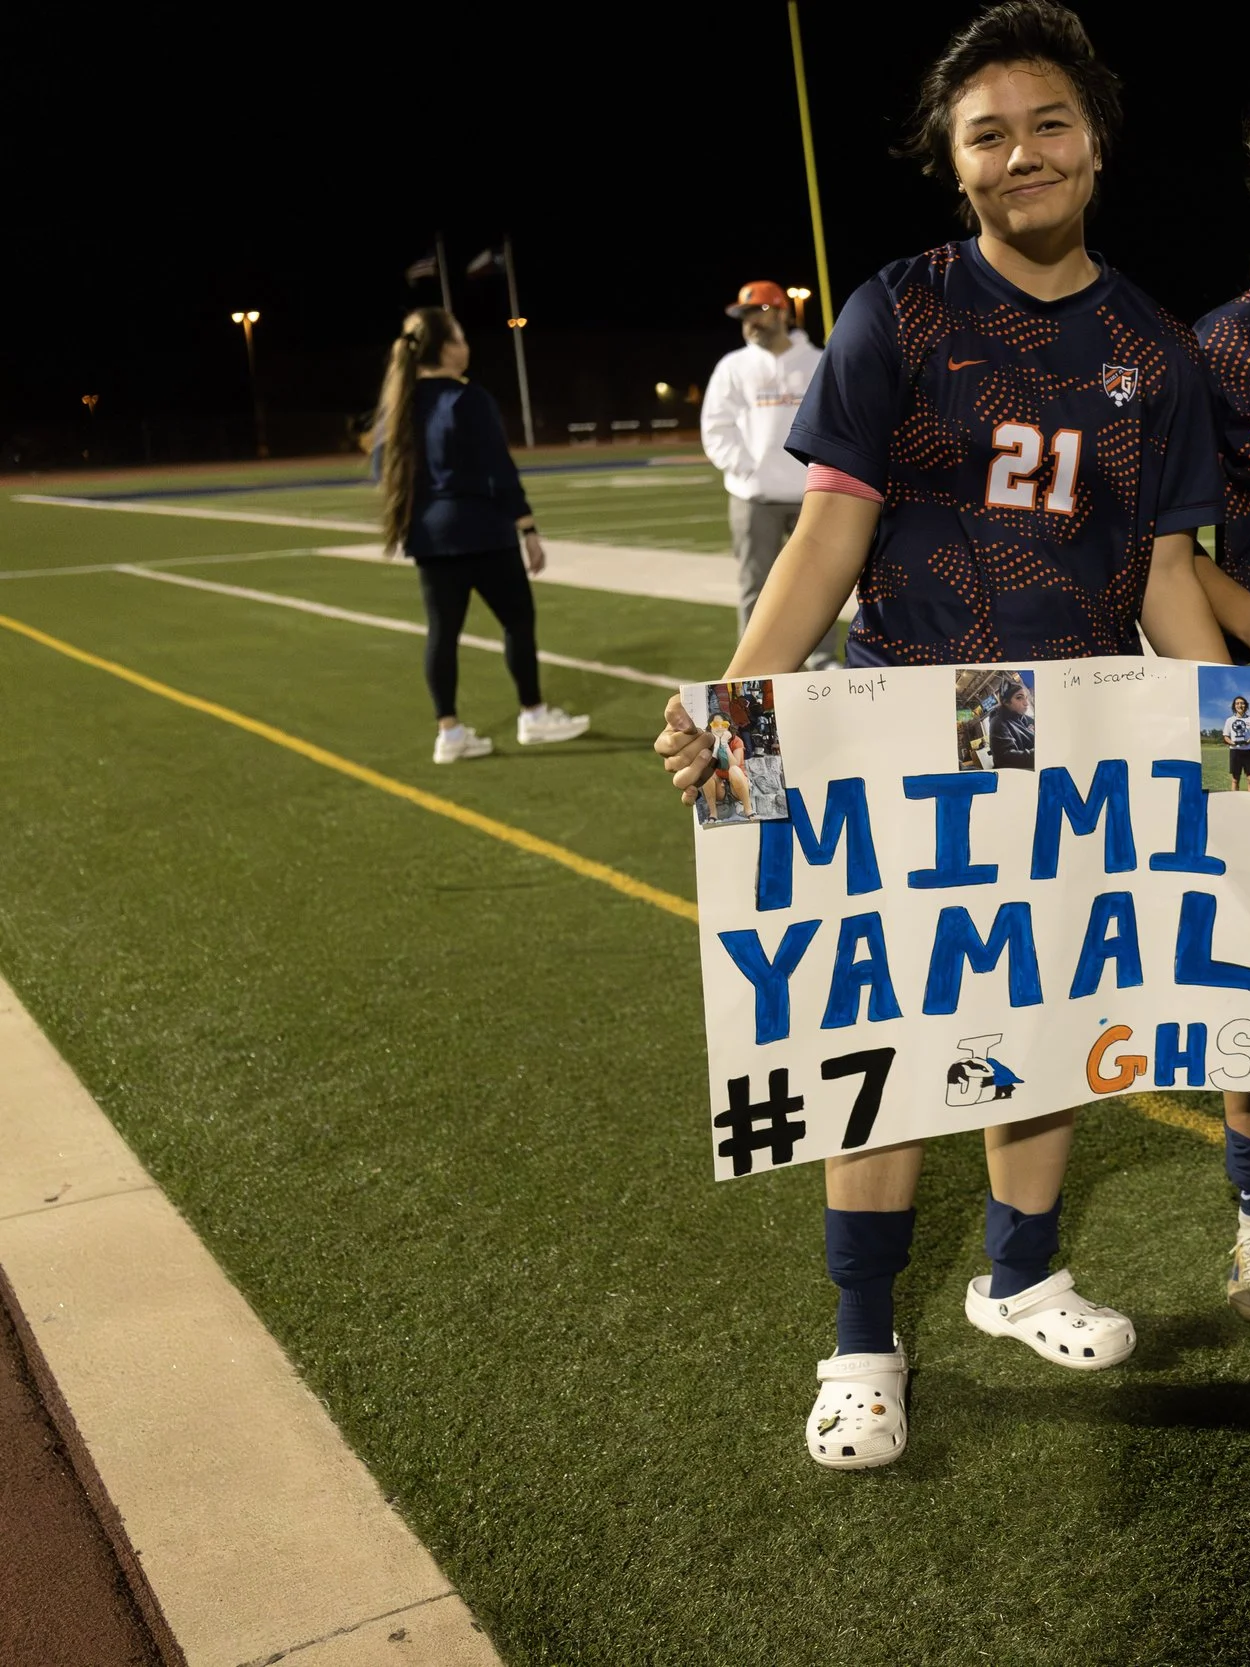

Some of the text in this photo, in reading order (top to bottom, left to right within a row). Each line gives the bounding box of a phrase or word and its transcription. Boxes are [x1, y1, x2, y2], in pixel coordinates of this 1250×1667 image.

[985, 421, 1082, 517] 21
[755, 758, 1227, 912] MIMI
[713, 1046, 897, 1177] #7
